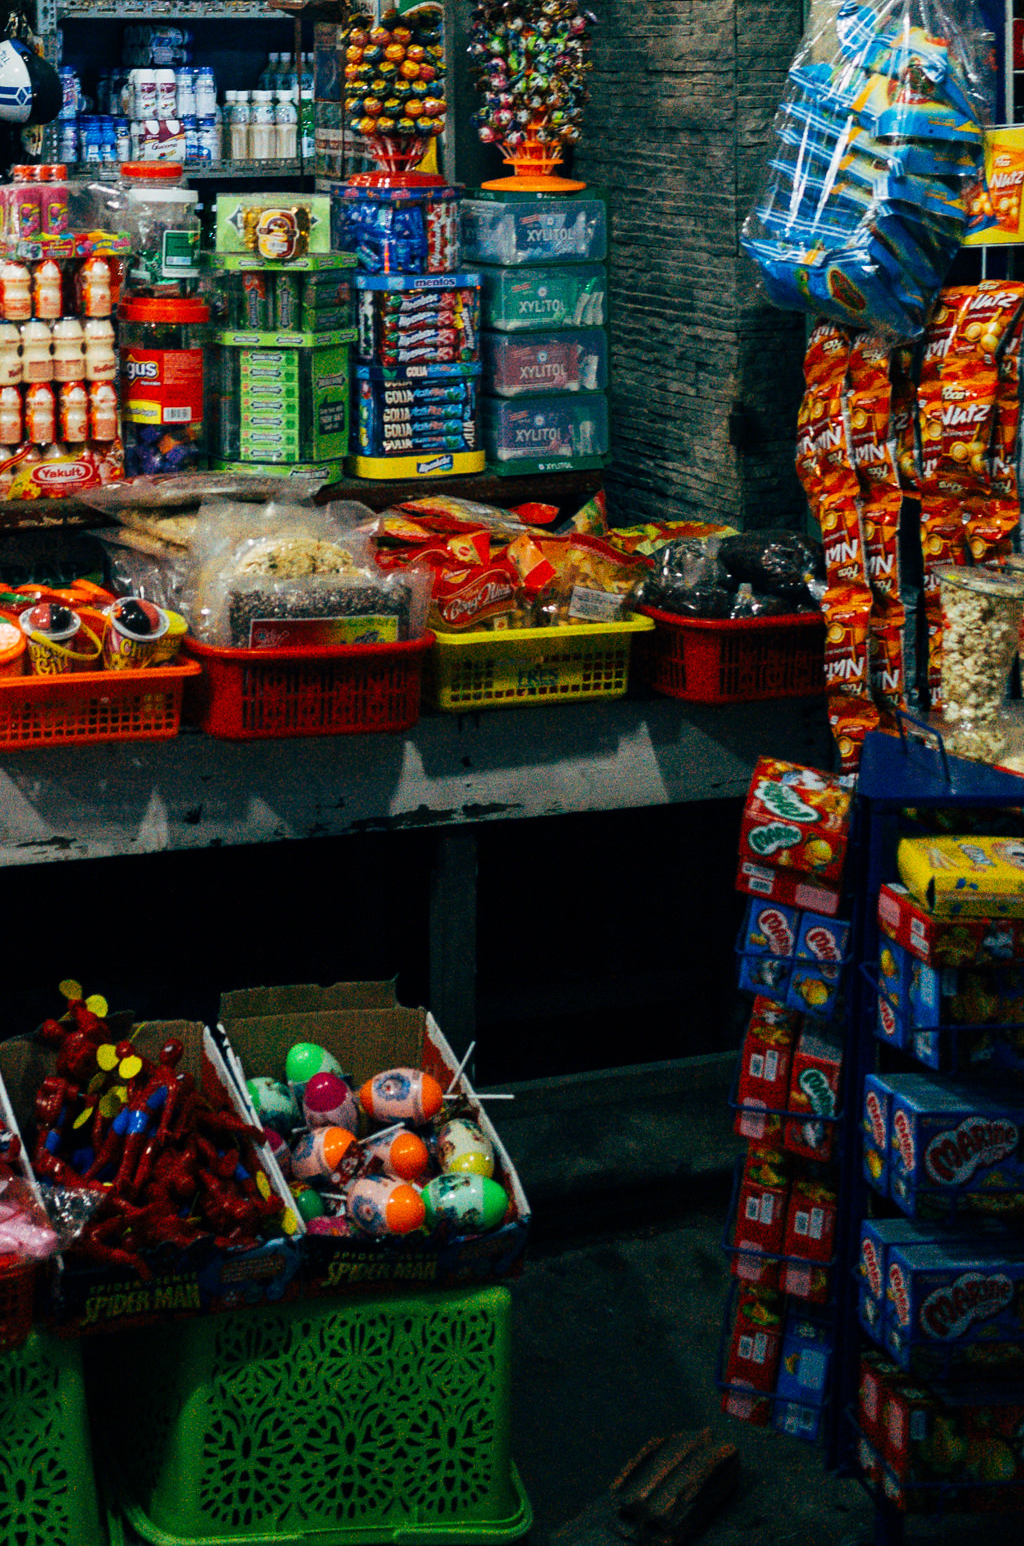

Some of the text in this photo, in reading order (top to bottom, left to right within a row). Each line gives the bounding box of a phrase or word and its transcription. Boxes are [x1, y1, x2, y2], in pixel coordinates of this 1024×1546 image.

[989, 170, 1024, 189] Nutz
[526, 228, 574, 243] XYLITOL
[414, 277, 456, 288] mentos
[518, 299, 566, 313] XYLITOL
[406, 365, 428, 378] GOLIA
[519, 364, 567, 380] XYLITOL
[384, 390, 414, 405] GOLIA
[383, 408, 411, 422] GOLIA
[941, 404, 991, 425] Nutz
[384, 423, 413, 438] GOLIA
[545, 460, 574, 470] XYLITOL
[42, 468, 84, 480] Yakult
[79, 1282, 201, 1329] SPIDER-MAN
